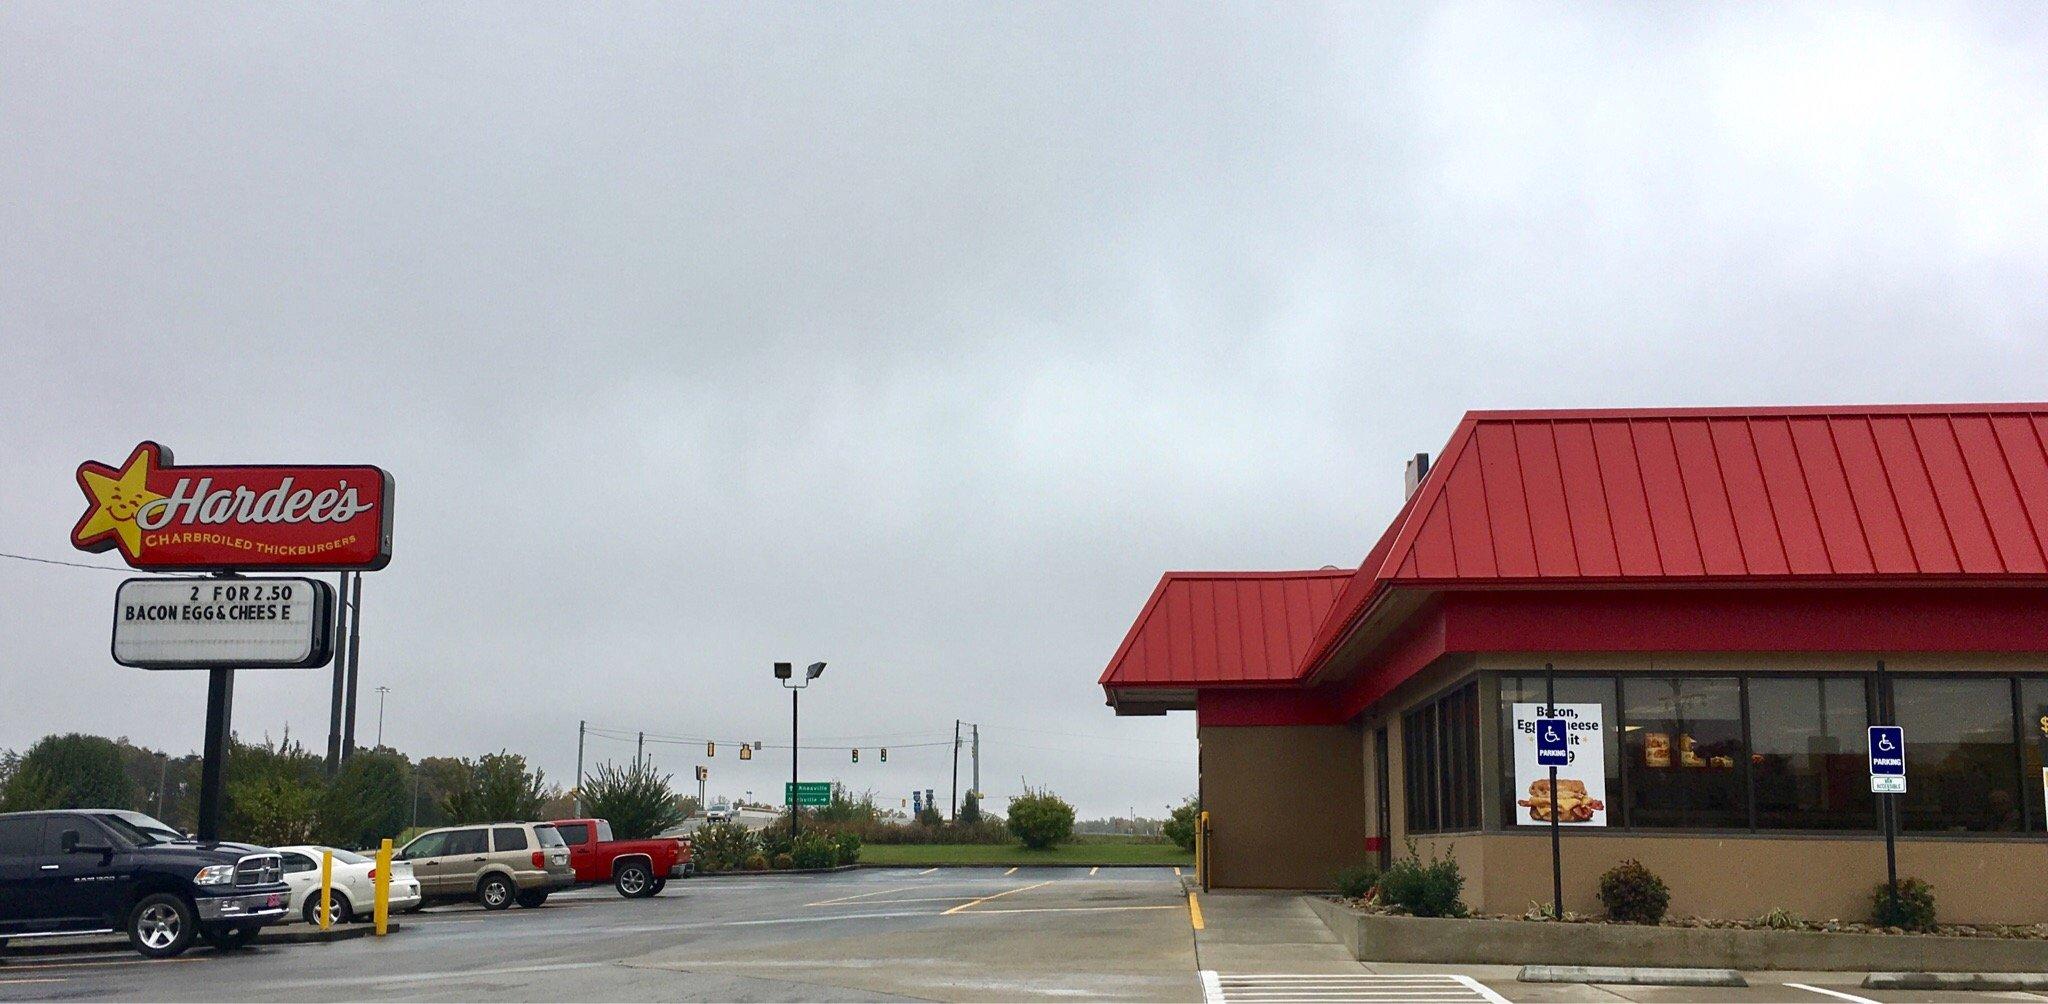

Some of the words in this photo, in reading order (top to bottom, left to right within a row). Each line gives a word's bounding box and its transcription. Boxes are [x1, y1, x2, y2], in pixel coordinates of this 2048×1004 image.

[135, 477, 373, 530] Hardee's
[145, 531, 253, 551] CHARBROILED
[256, 535, 358, 556] THICKBURGERS
[190, 586, 200, 602] 2
[213, 586, 250, 602] FOR
[254, 586, 293, 602] 2.50
[125, 605, 177, 621] BACON
